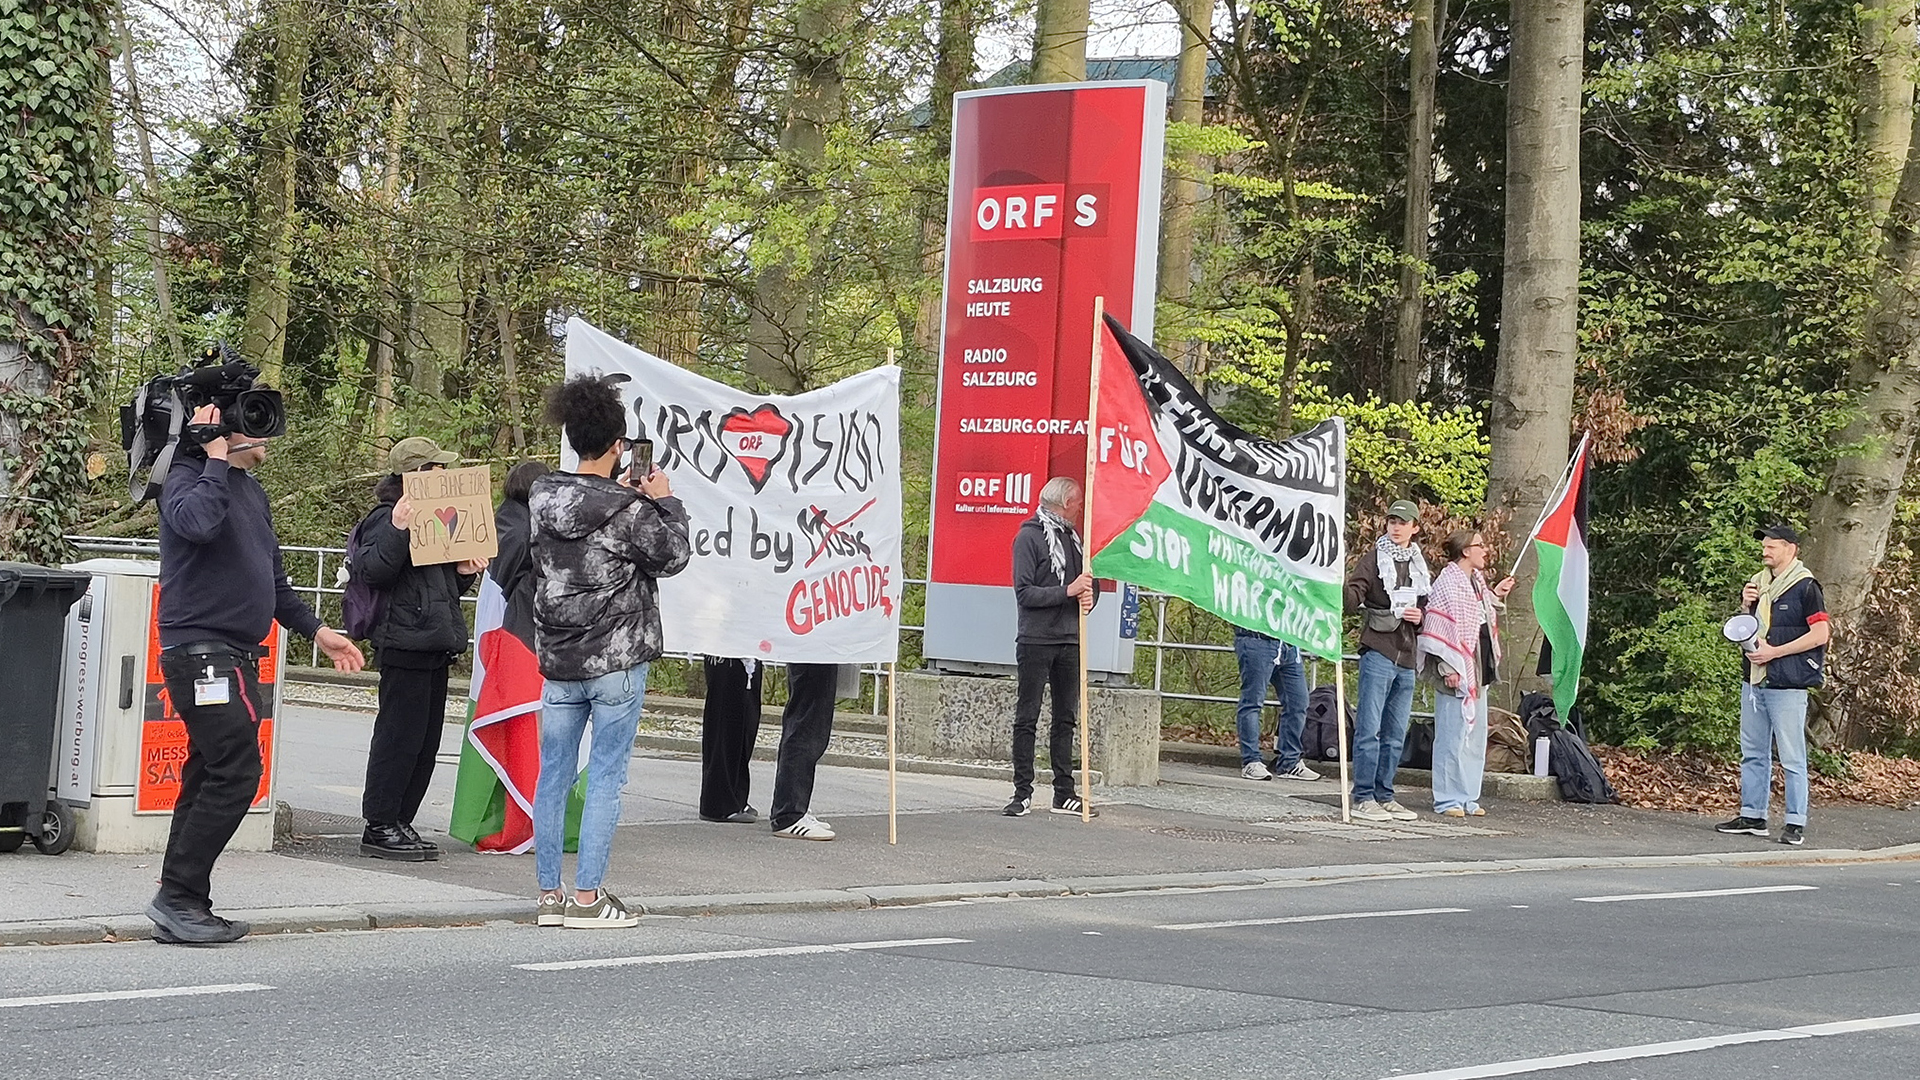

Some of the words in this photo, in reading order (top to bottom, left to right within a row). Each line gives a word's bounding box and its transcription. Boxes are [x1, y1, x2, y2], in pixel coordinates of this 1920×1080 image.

[977, 195, 1057, 231] ORF
[1074, 194, 1098, 227] S
[967, 277, 1043, 294] SALZBURG
[966, 301, 1011, 317] HEUTE
[963, 348, 1007, 363] RADIO
[962, 371, 1037, 387] SALZBURG
[738, 435, 763, 451] ORF
[1100, 421, 1151, 476] FÜR
[959, 477, 1001, 497] ORF
[955, 503, 975, 513] Kultur
[975, 505, 986, 513] und
[987, 504, 1028, 514] Information
[748, 506, 795, 574] by
[1129, 520, 1191, 576] STOP
[785, 565, 893, 636] GENOCIDE
[1211, 563, 1265, 620] WAR
[70, 624, 90, 788] progress-werbung.at
[147, 746, 187, 762] MESS
